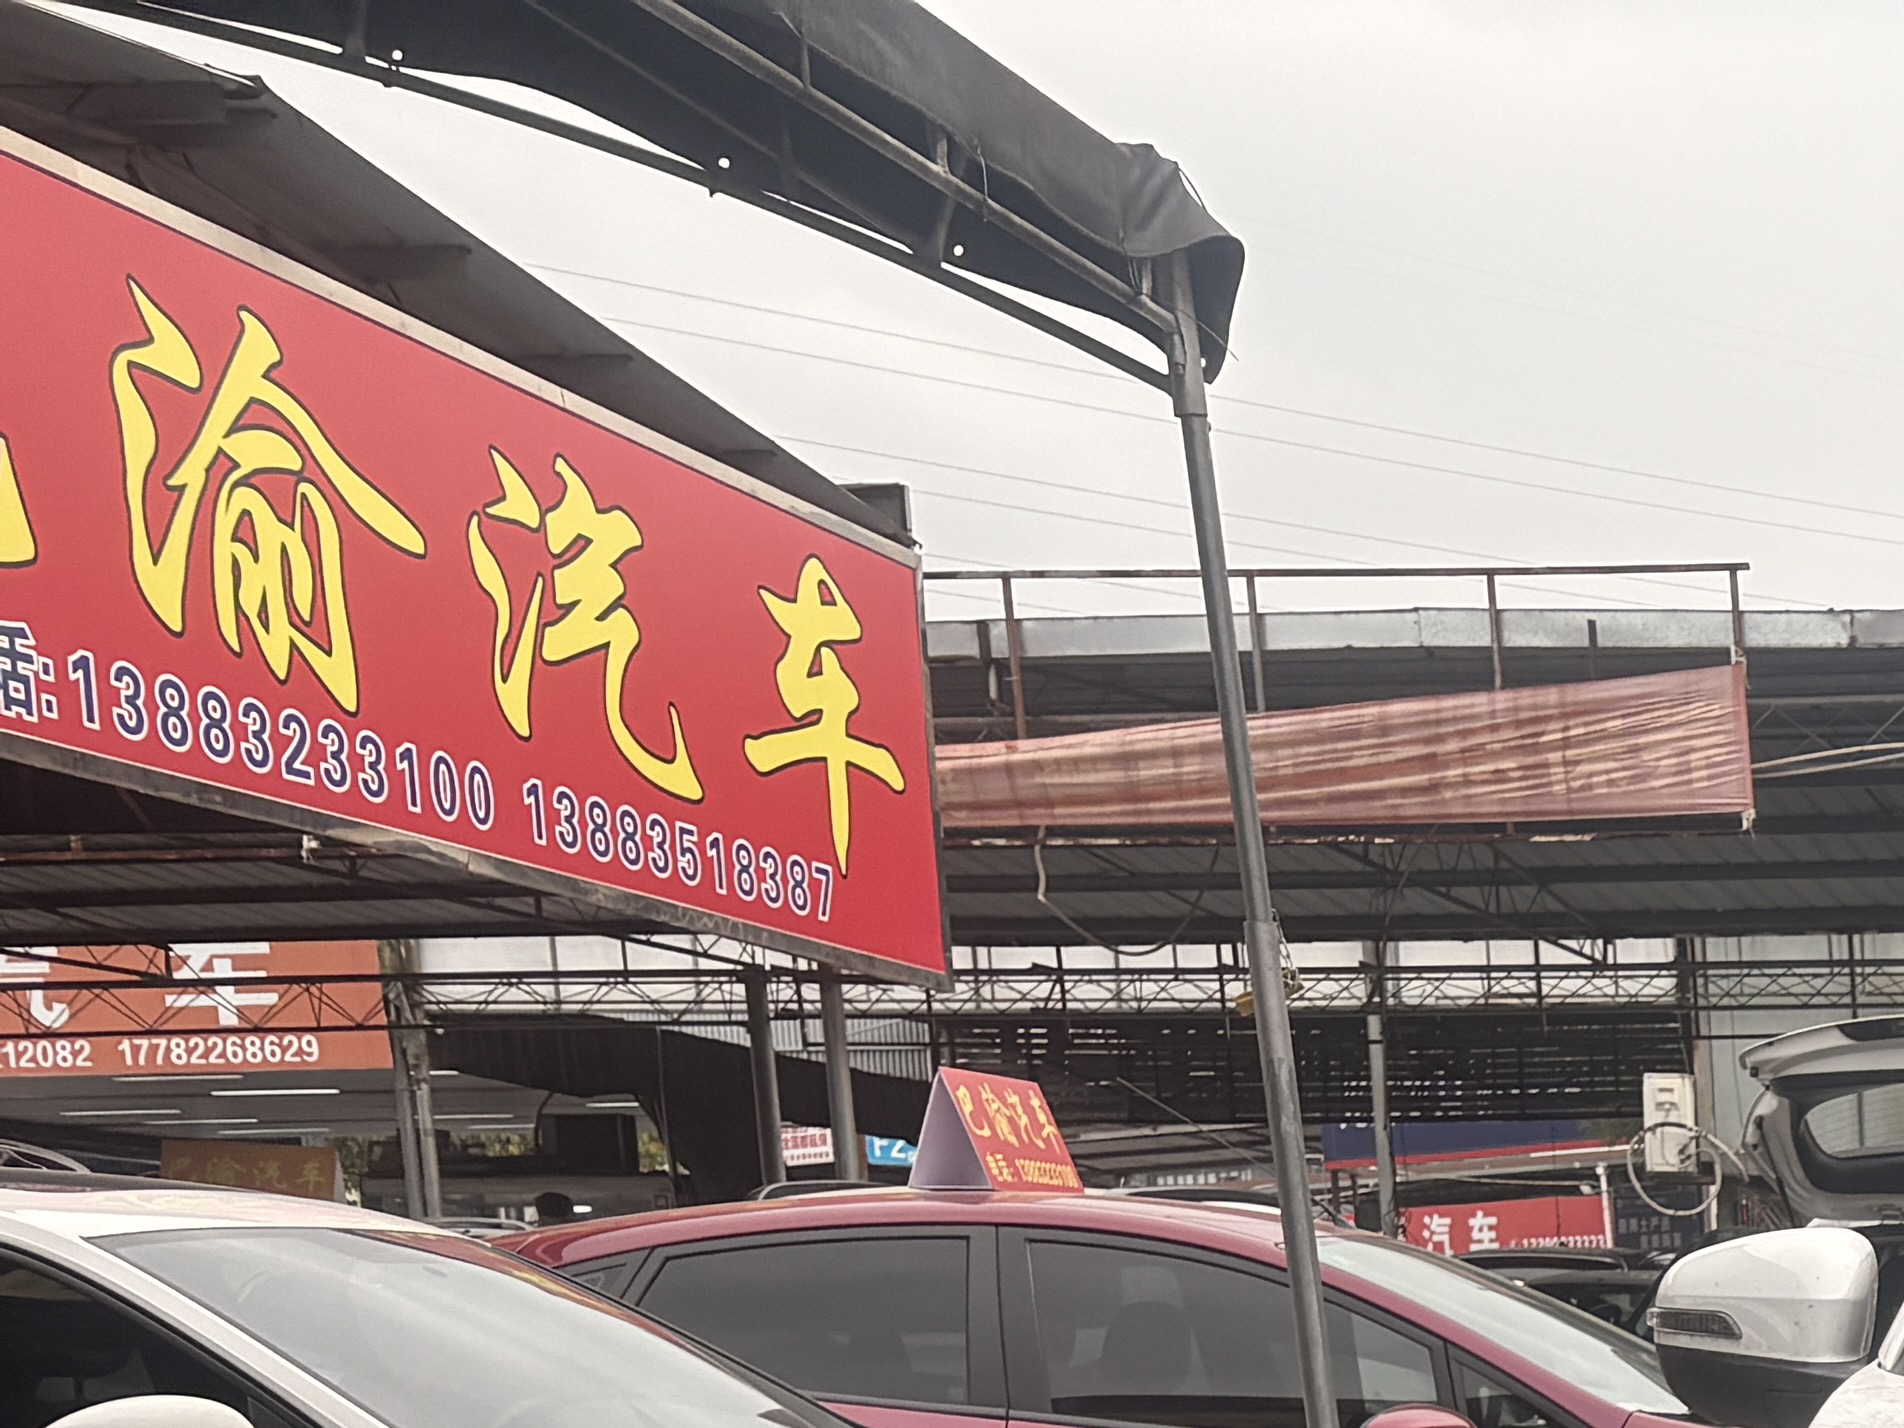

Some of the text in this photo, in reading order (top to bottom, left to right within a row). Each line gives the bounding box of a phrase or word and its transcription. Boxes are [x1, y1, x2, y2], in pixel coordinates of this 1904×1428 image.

[0, 274, 905, 876] 渝汽车
[523, 777, 834, 923] 13883518387
[0, 1034, 320, 1069] 12082 17782268629
